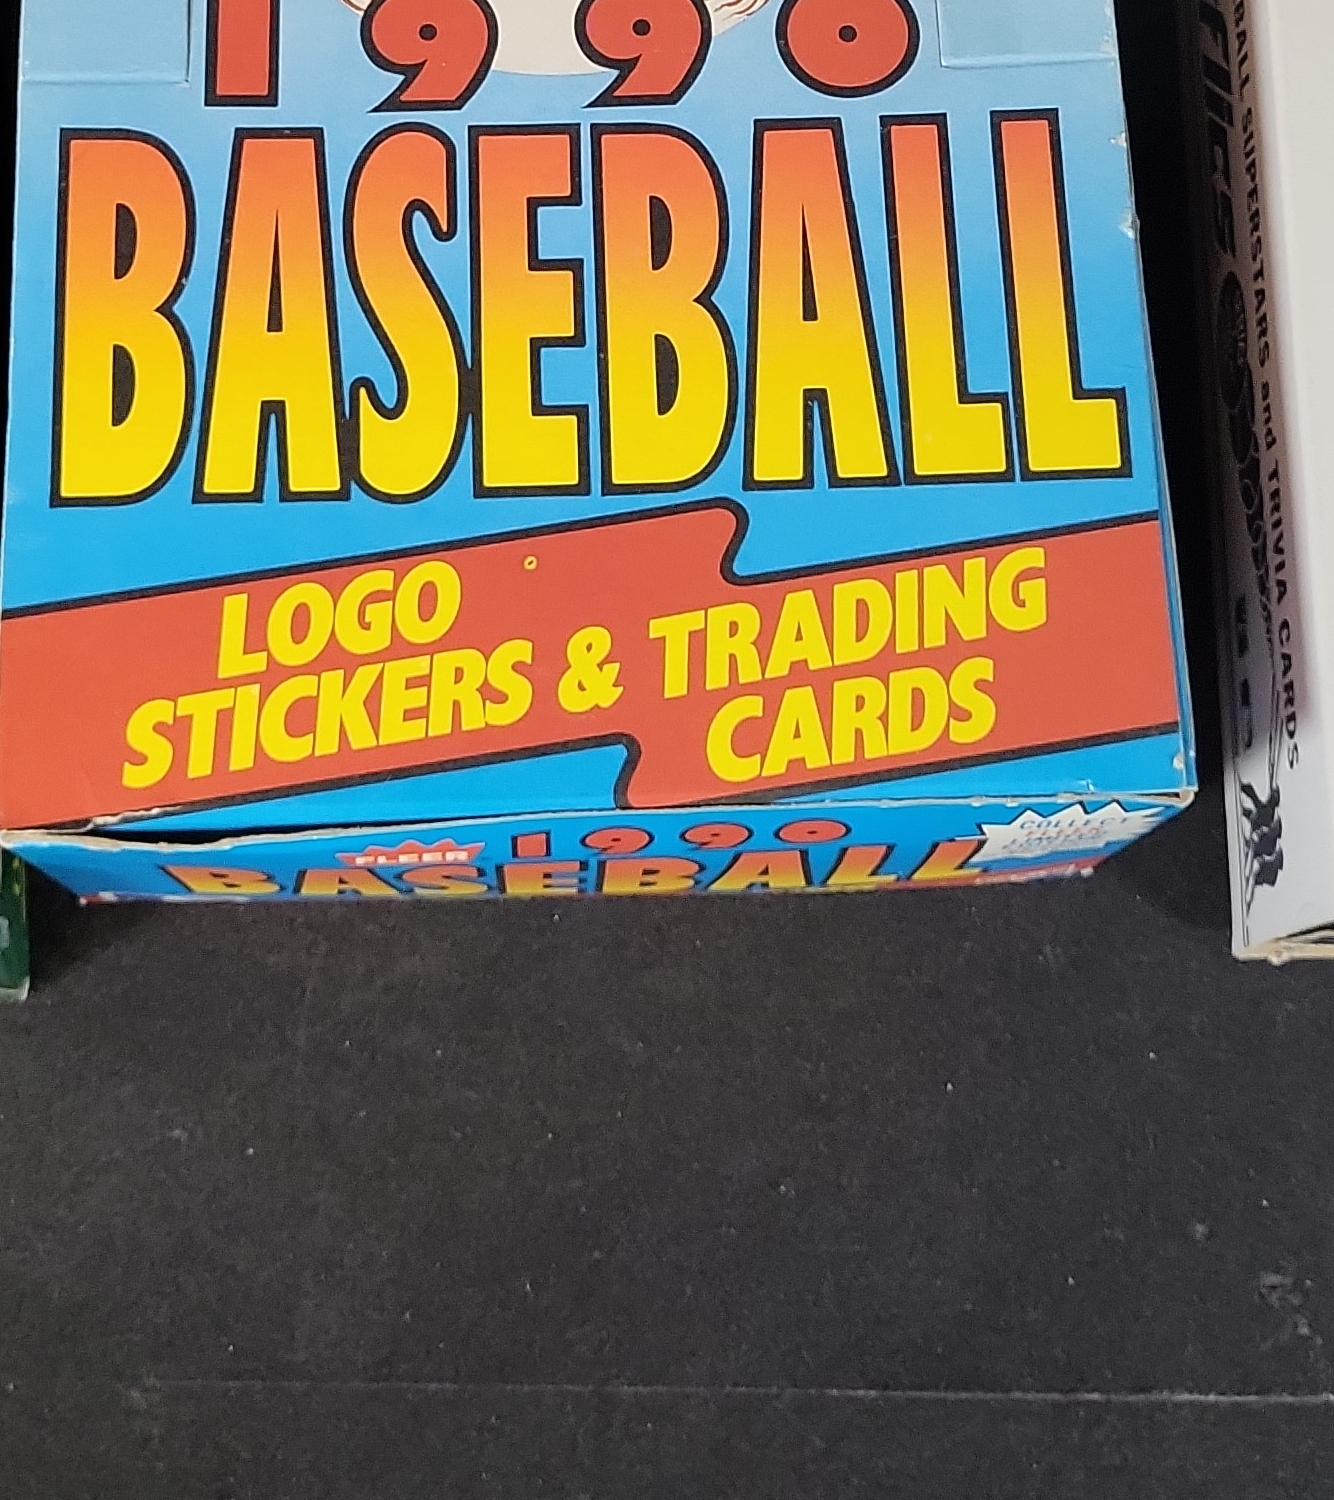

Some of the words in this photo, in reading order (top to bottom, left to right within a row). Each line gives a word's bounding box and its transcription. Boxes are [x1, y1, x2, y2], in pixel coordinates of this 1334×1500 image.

[1240, 107, 1271, 369] SUPERSTARS
[49, 107, 1135, 507] BASEBALL
[1259, 378, 1277, 452] and
[1266, 466, 1289, 605] TRIVIA
[121, 638, 534, 790] STICKERS
[557, 625, 624, 714] &
[648, 546, 1048, 699] TRADING
[216, 560, 462, 680] LOGO
[705, 655, 998, 783] CARDS
[1278, 616, 1301, 771] CARDS
[161, 838, 987, 897] BASEBALL
[511, 818, 852, 859] 1990
